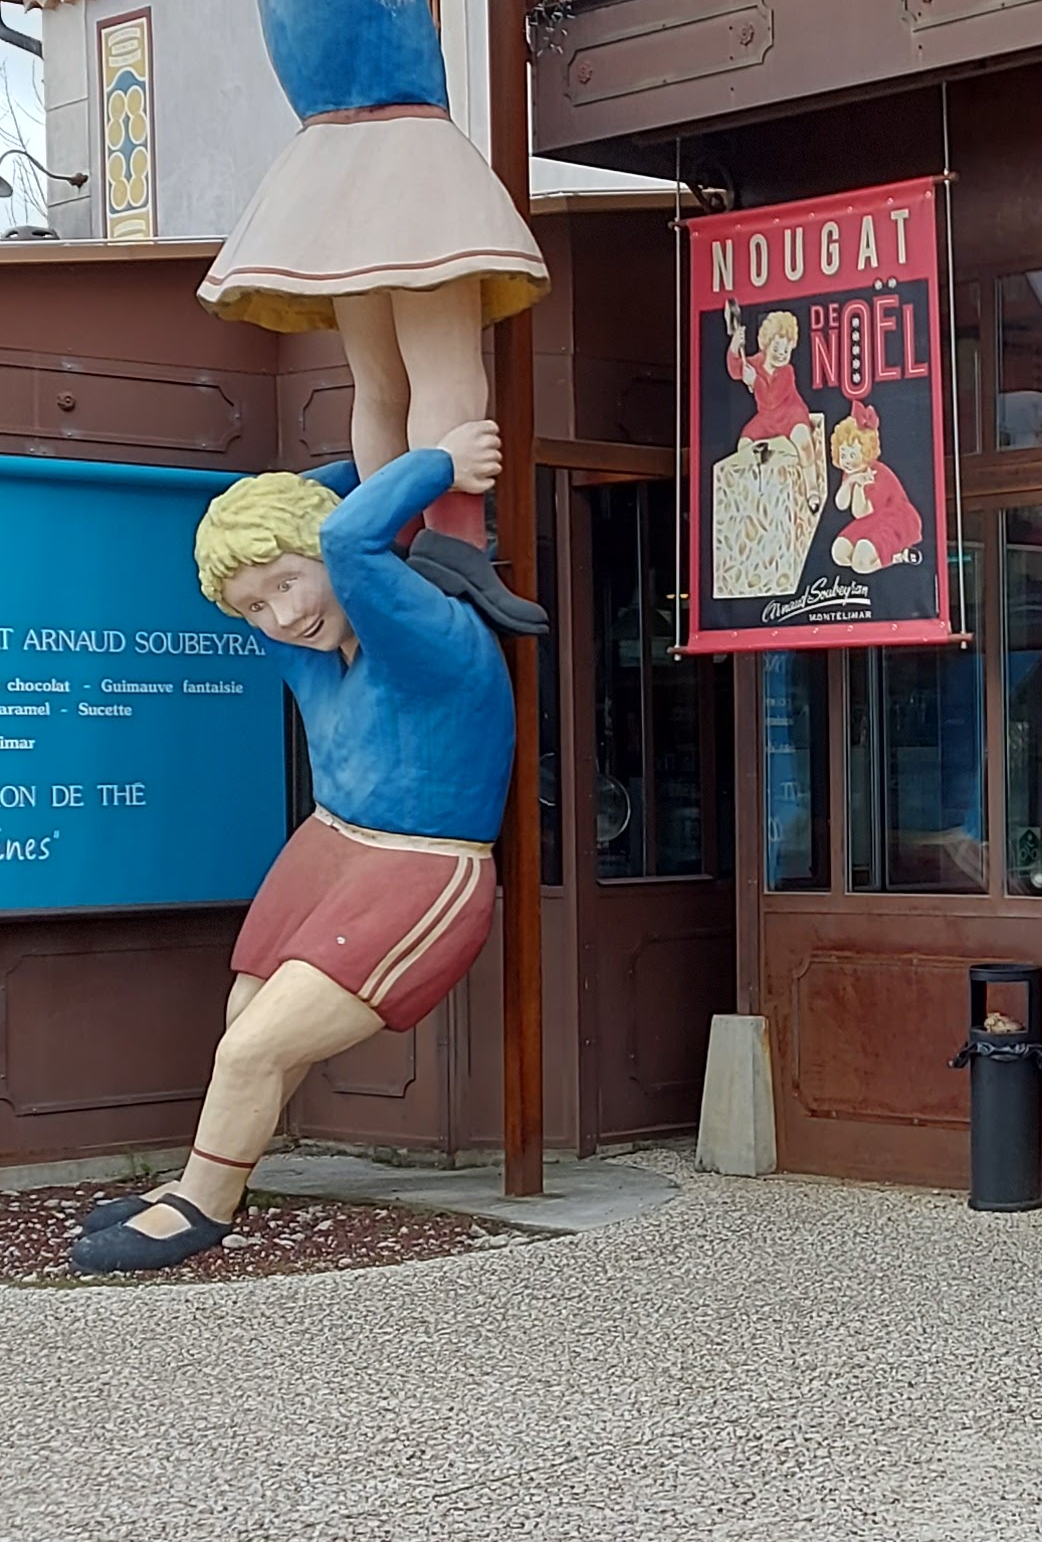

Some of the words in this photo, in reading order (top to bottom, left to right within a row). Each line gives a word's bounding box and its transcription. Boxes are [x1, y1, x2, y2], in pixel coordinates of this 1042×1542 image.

[711, 208, 911, 293] NOUGAT
[810, 303, 840, 330] DE
[811, 278, 929, 399] NOËL
[806, 575, 869, 606] Soubeyran
[23, 628, 127, 653] ARNAUD
[134, 631, 267, 656] SOUBEYRA
[7, 678, 71, 693] chocolat
[101, 679, 174, 694] Guimauve
[182, 679, 244, 694] fantaisie
[0, 702, 51, 716] aramel
[78, 702, 133, 717] Sucette
[0, 784, 37, 808] ON
[51, 784, 85, 808] DE
[96, 781, 147, 807] THÉ
